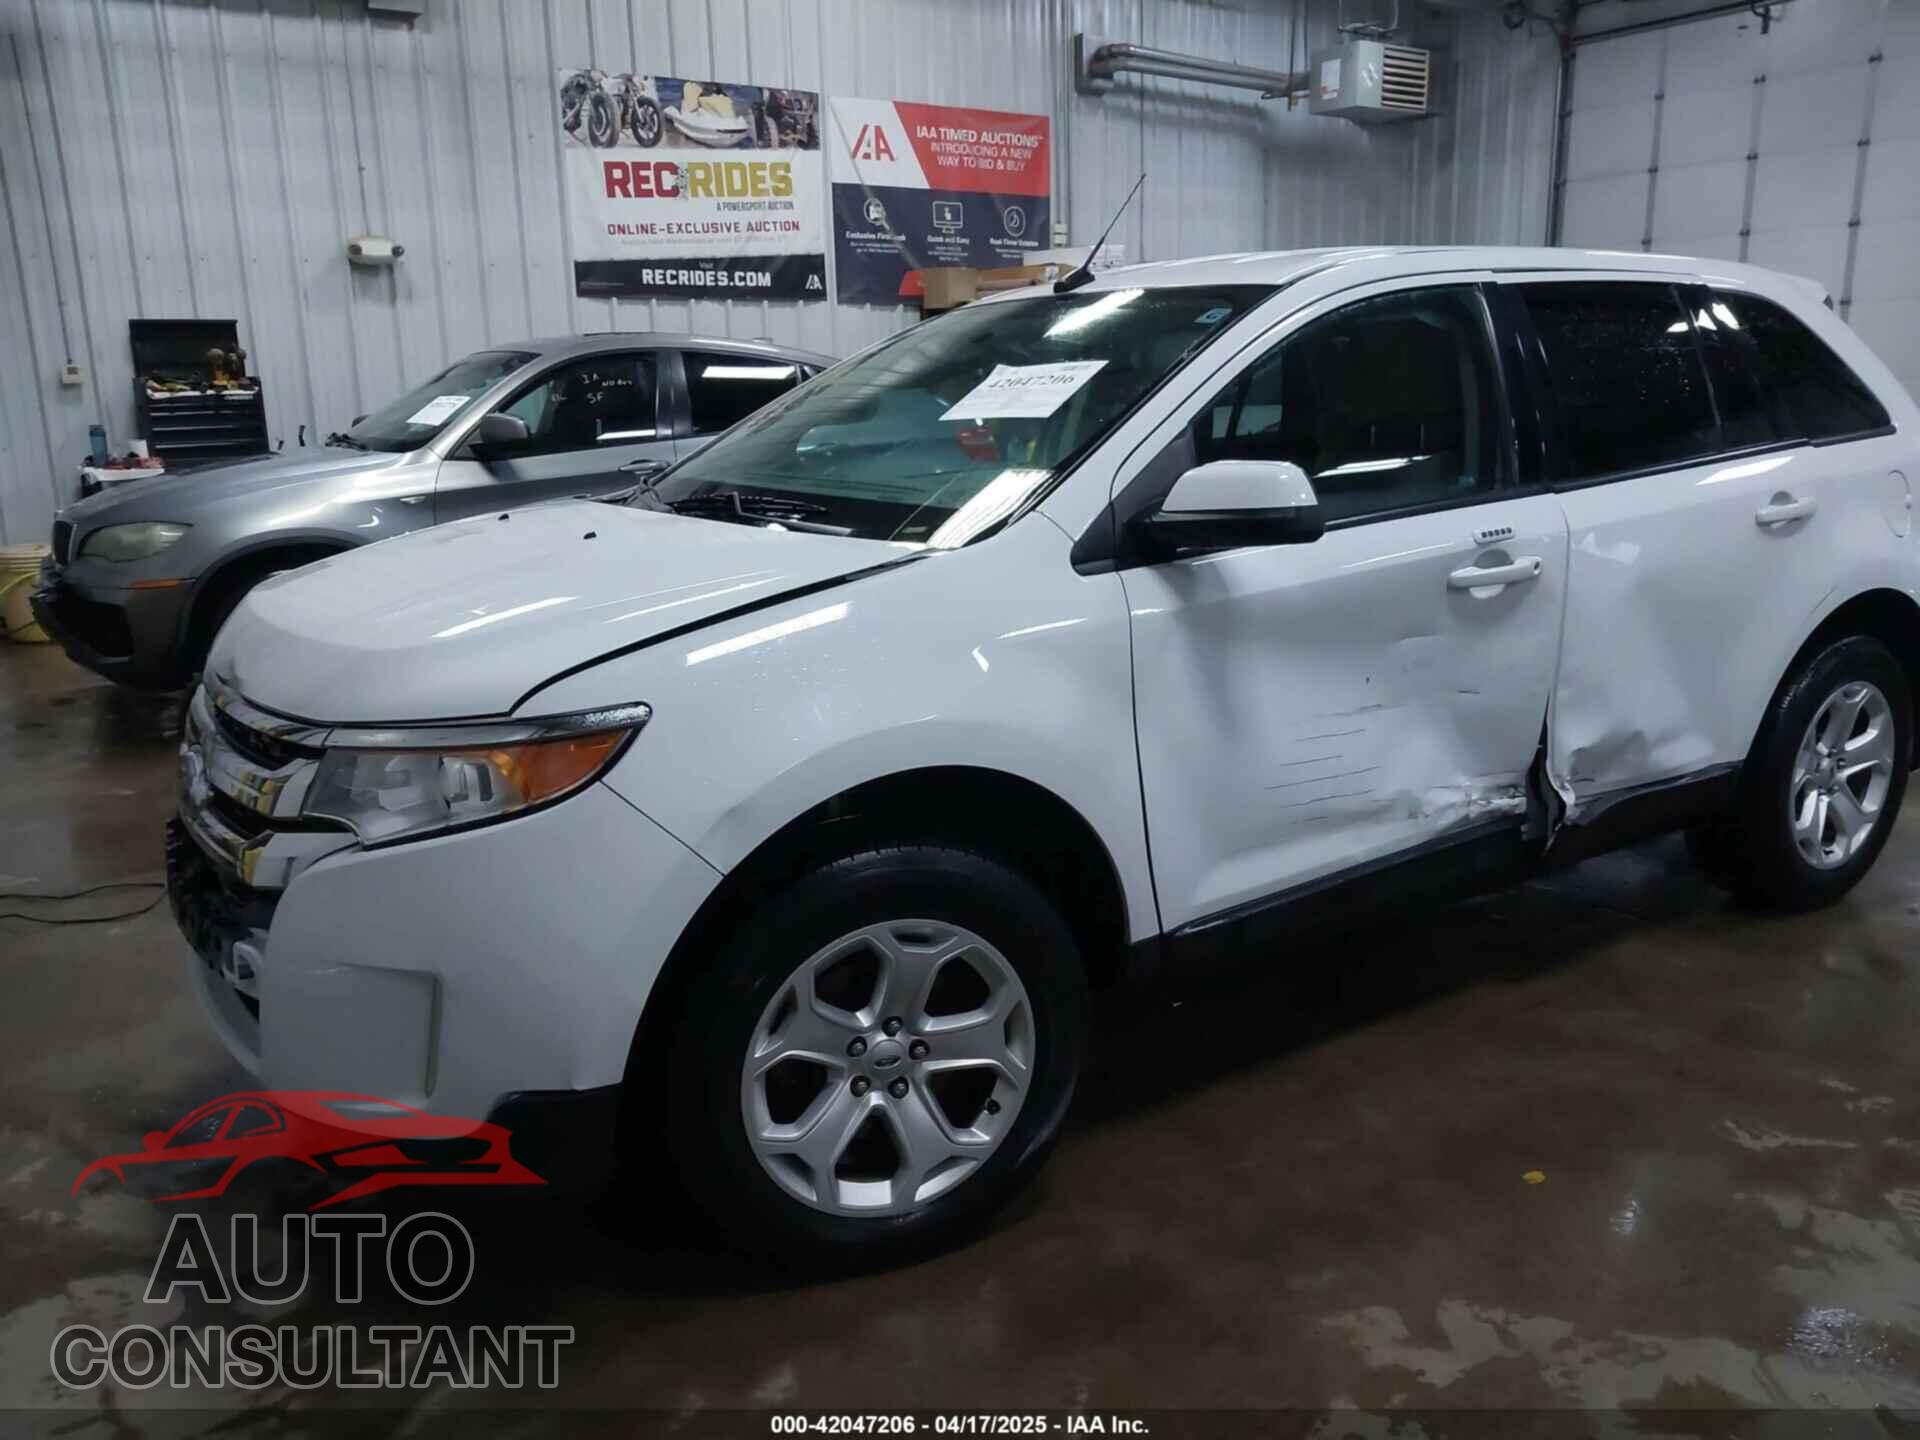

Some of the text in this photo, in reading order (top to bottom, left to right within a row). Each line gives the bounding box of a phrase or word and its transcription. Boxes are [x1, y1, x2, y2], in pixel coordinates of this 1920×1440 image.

[916, 126, 937, 138] IAA
[938, 128, 977, 142] TIMED
[930, 142, 1032, 159] INTRODUCING A NEW
[937, 155, 1026, 171] WAY TO BID & BUY
[767, 201, 794, 210] AUCTION
[608, 220, 801, 235] ONLINE-EXCLUSIVE AUCTION
[642, 268, 772, 287] RECRIDES.COM
